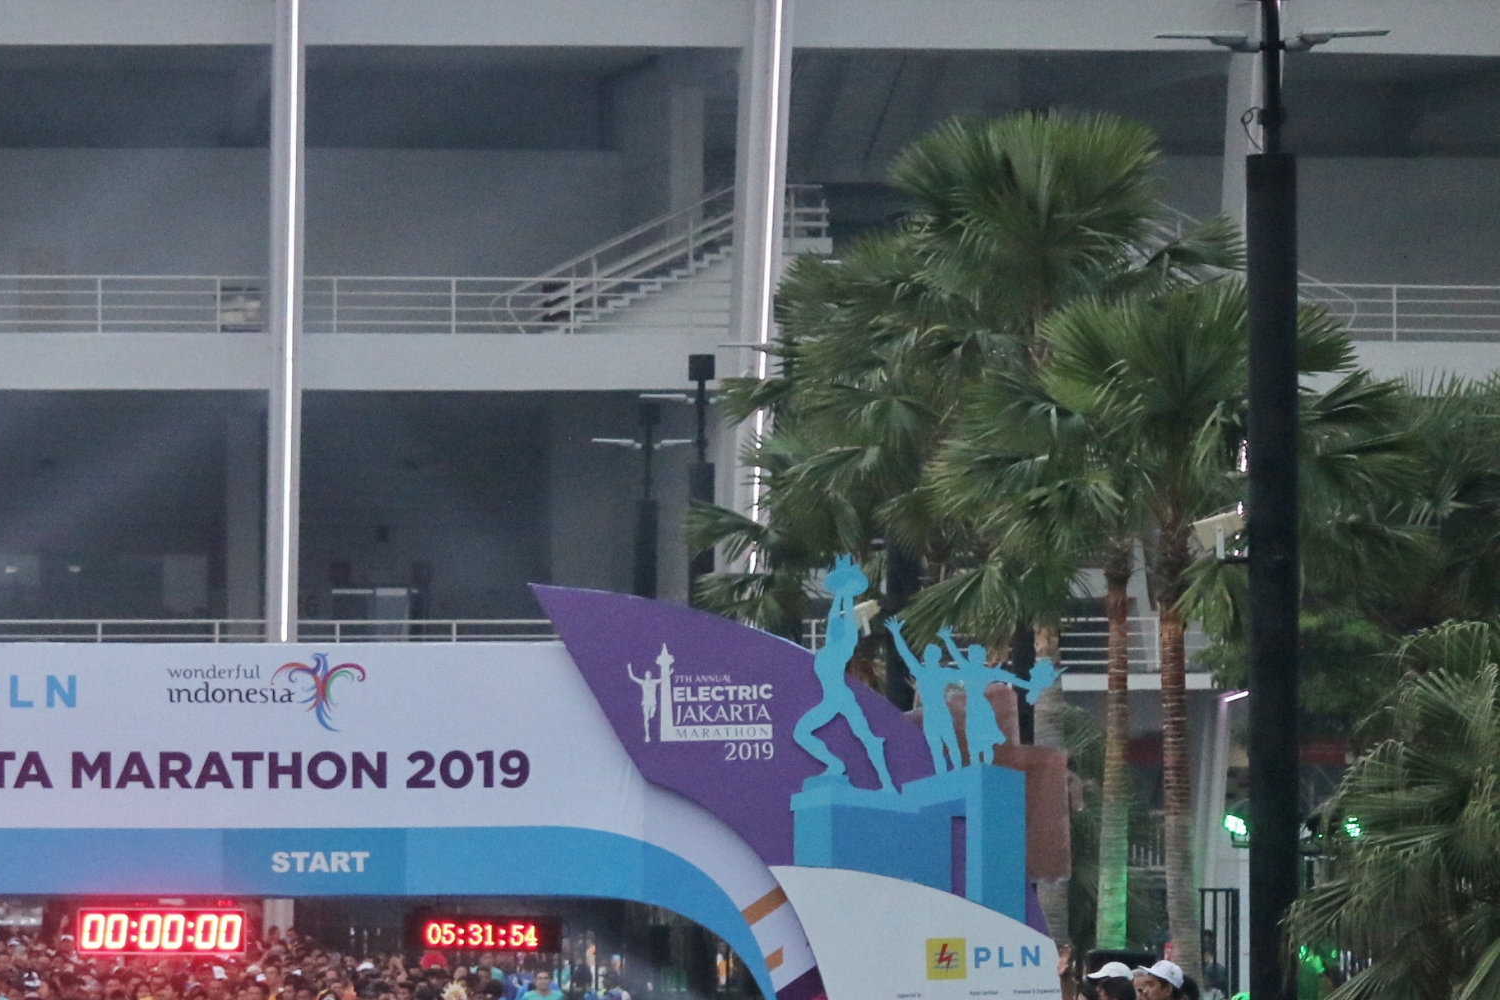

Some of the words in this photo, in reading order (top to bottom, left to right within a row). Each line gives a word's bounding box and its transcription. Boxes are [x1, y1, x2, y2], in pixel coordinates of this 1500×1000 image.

[167, 663, 261, 681] wonderful
[674, 674, 693, 683] 7TH
[695, 674, 733, 683] ANNUAL
[167, 681, 297, 705] indonesia
[673, 684, 774, 702] ELECTRIC
[675, 703, 772, 725] JAKARTA
[675, 726, 769, 739] MARATHON
[725, 742, 775, 760] 2019
[71, 750, 388, 789] MARATHON
[406, 749, 531, 789] 2019
[271, 851, 370, 873] START
[81, 913, 243, 949] 00:00:00
[426, 922, 538, 948] 05:31:54
[974, 945, 1041, 969] PLN
